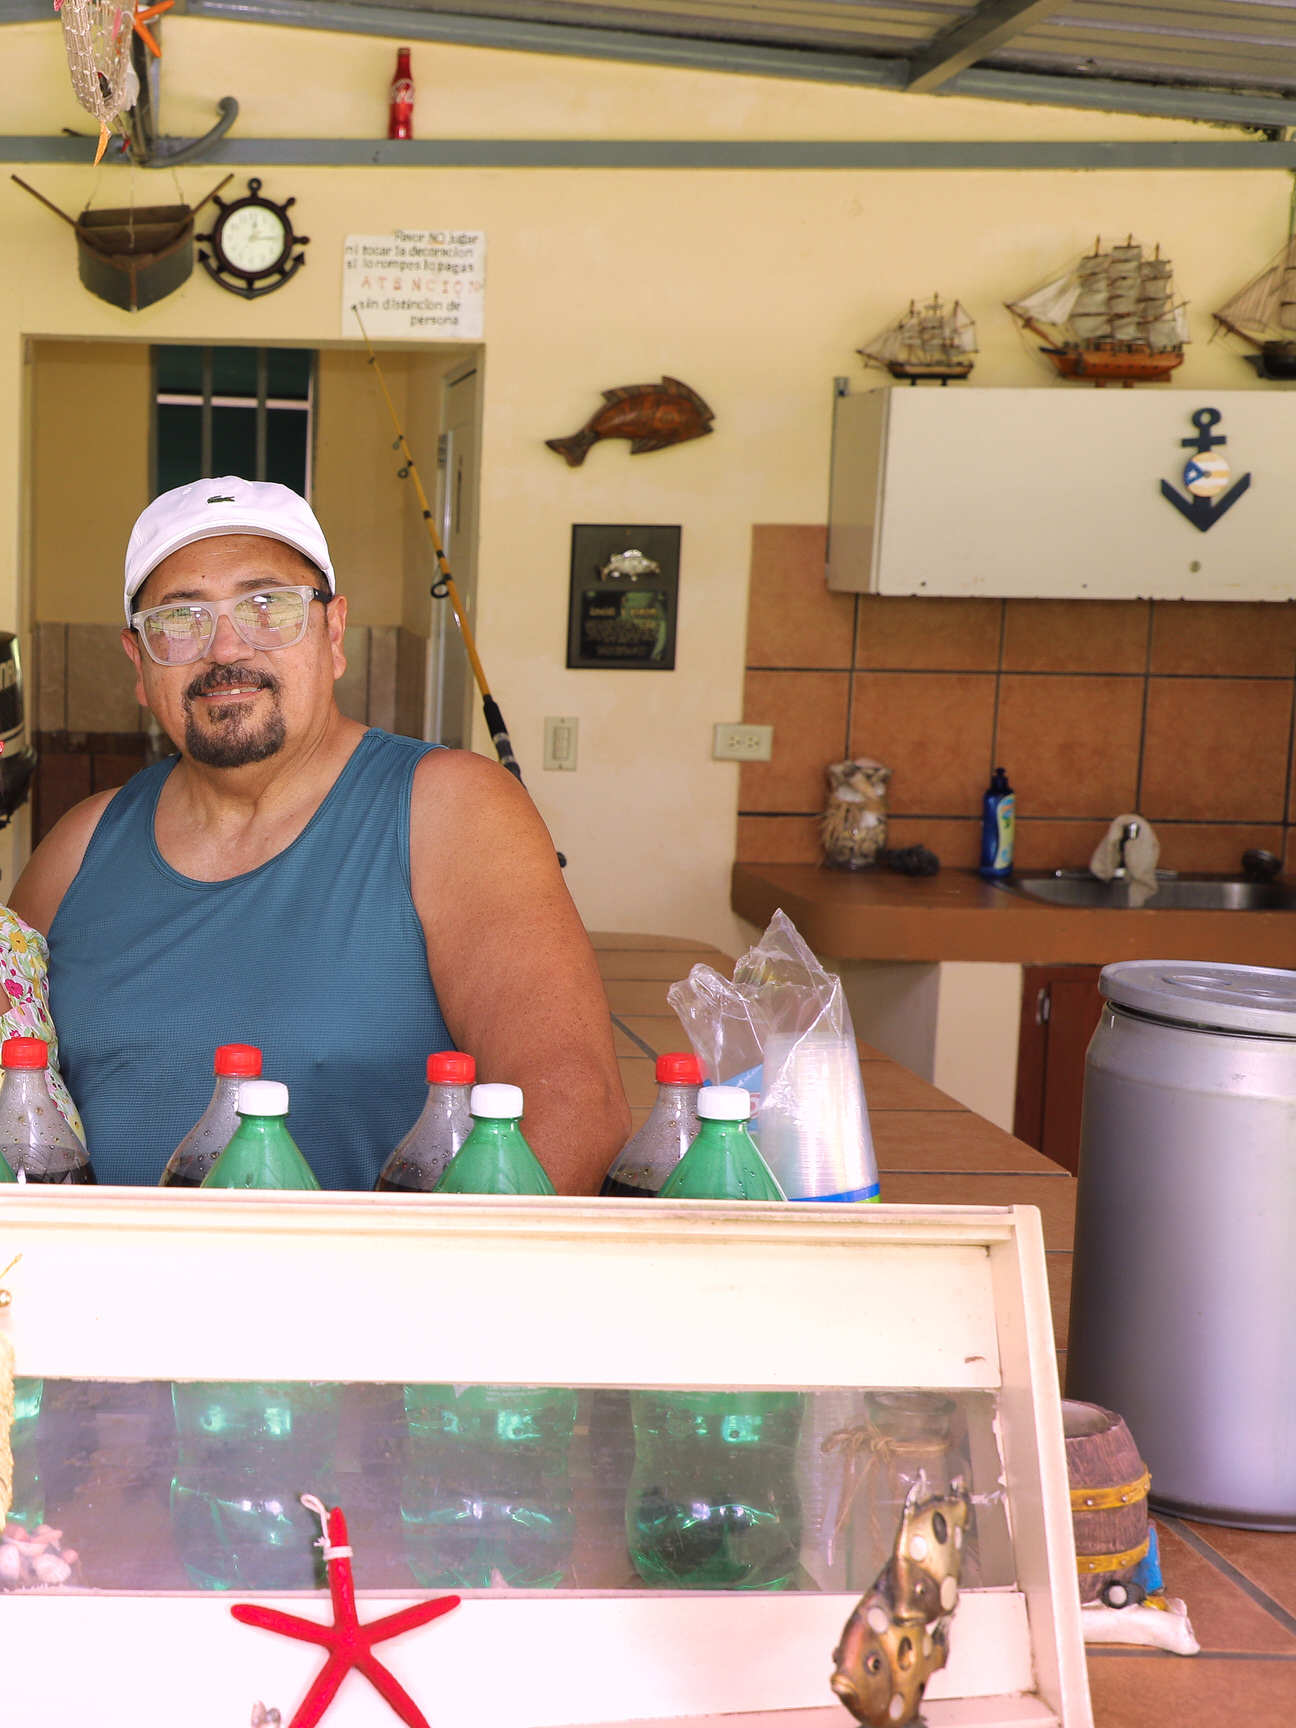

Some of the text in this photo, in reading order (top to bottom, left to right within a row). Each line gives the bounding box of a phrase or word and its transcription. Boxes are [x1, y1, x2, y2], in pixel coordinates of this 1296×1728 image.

[394, 230, 478, 246] Favor NO jugar
[345, 245, 473, 258] ni tocar la decoracion
[347, 259, 474, 275] si lo rompes lo pagas
[361, 276, 481, 295] ATENCION
[358, 298, 461, 312] sin distincion de
[409, 315, 459, 327] persona
